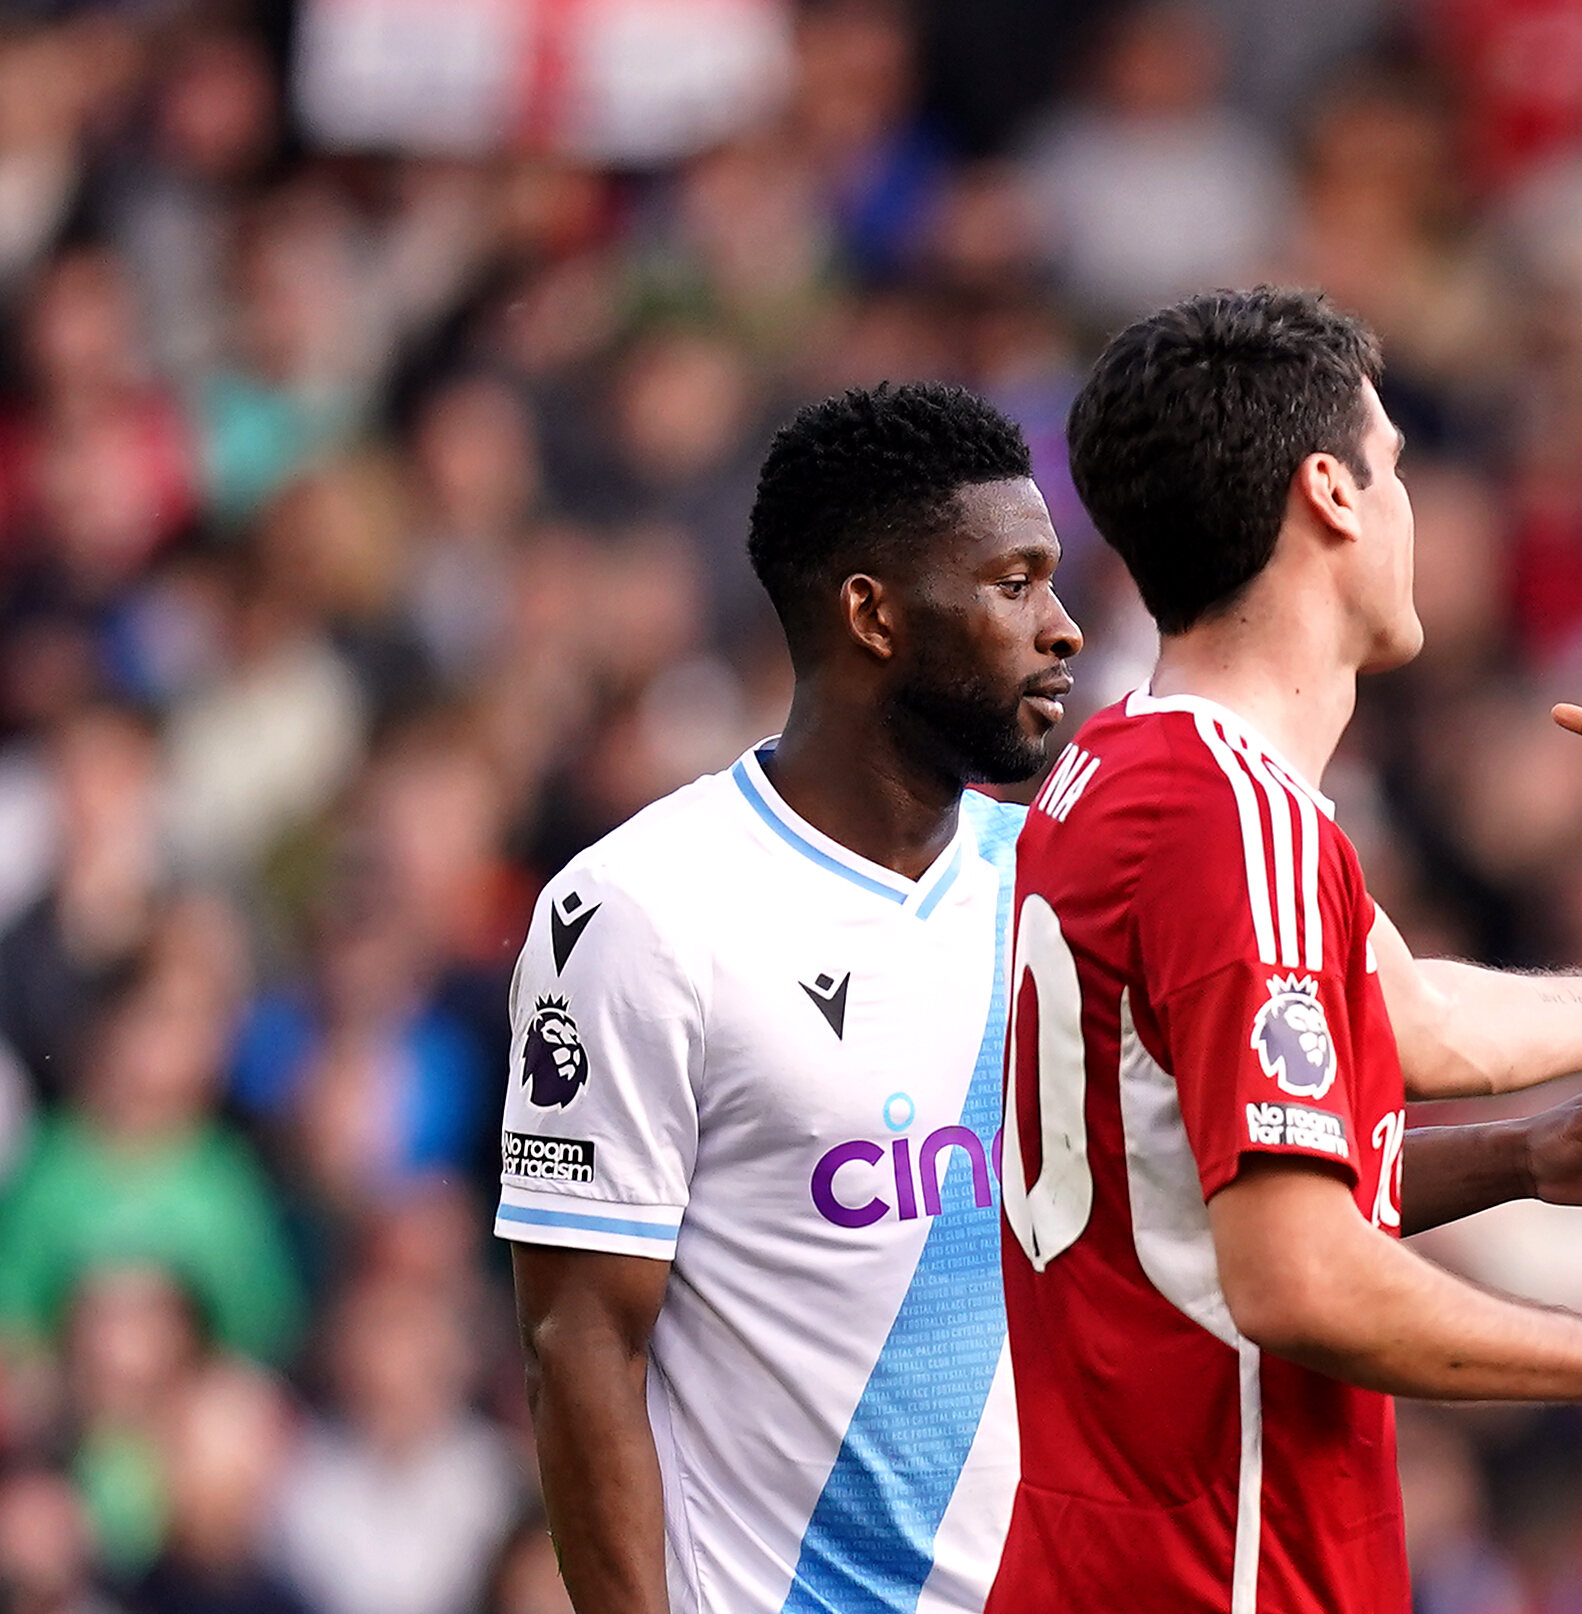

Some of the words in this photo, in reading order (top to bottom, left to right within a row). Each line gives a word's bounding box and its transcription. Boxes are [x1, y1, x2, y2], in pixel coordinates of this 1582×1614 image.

[1246, 1102, 1284, 1128] No
[1286, 1107, 1341, 1137] room
[503, 1132, 521, 1156] No
[523, 1139, 583, 1162] room
[811, 1092, 1000, 1229] cin
[521, 1157, 592, 1183] racism
